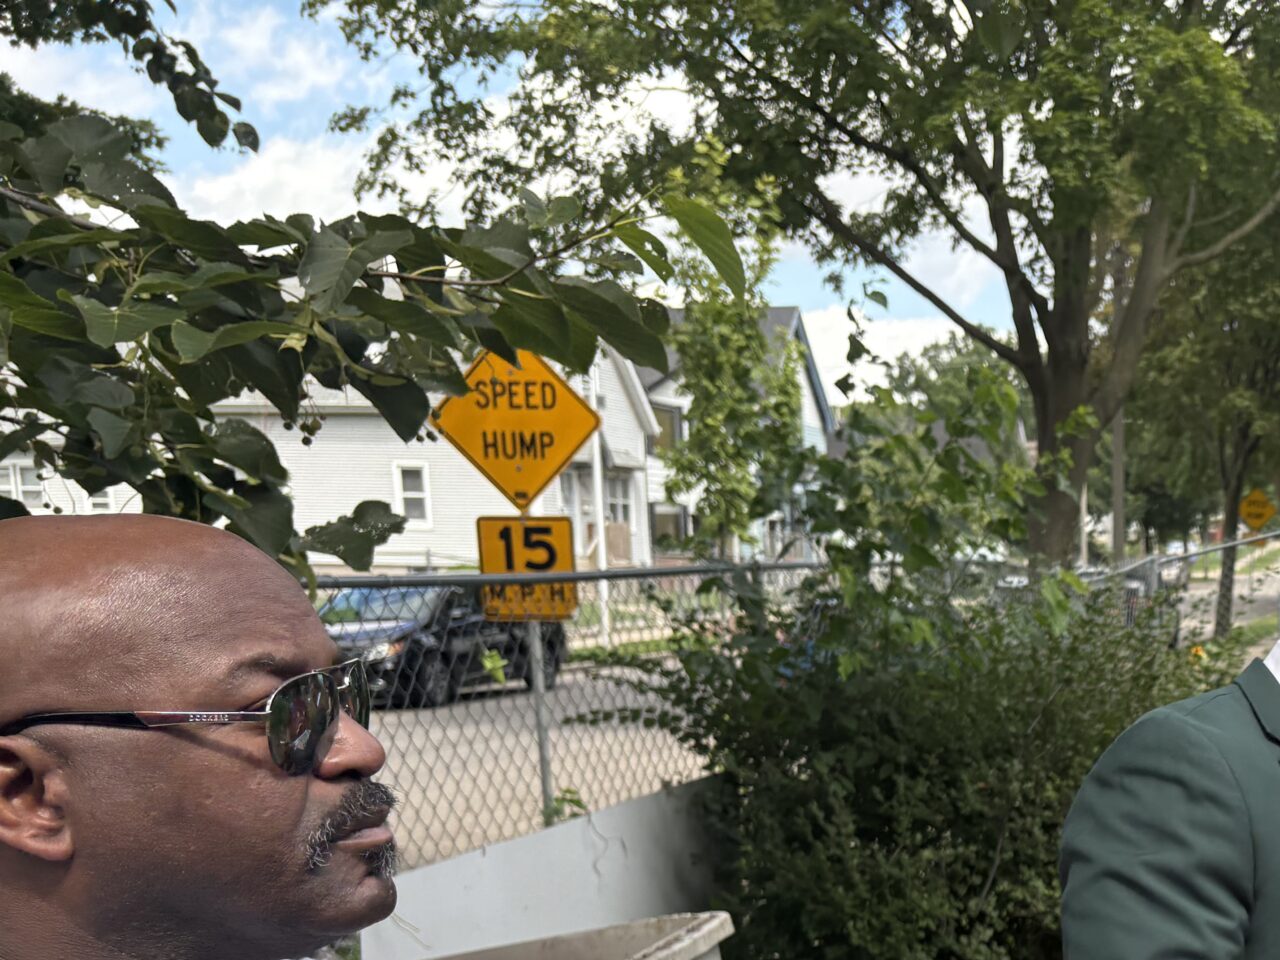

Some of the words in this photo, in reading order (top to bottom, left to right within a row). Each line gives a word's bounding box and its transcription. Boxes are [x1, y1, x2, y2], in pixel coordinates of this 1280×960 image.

[474, 380, 557, 410] SPEED
[482, 431, 554, 460] HUMP
[498, 526, 557, 571] 15
